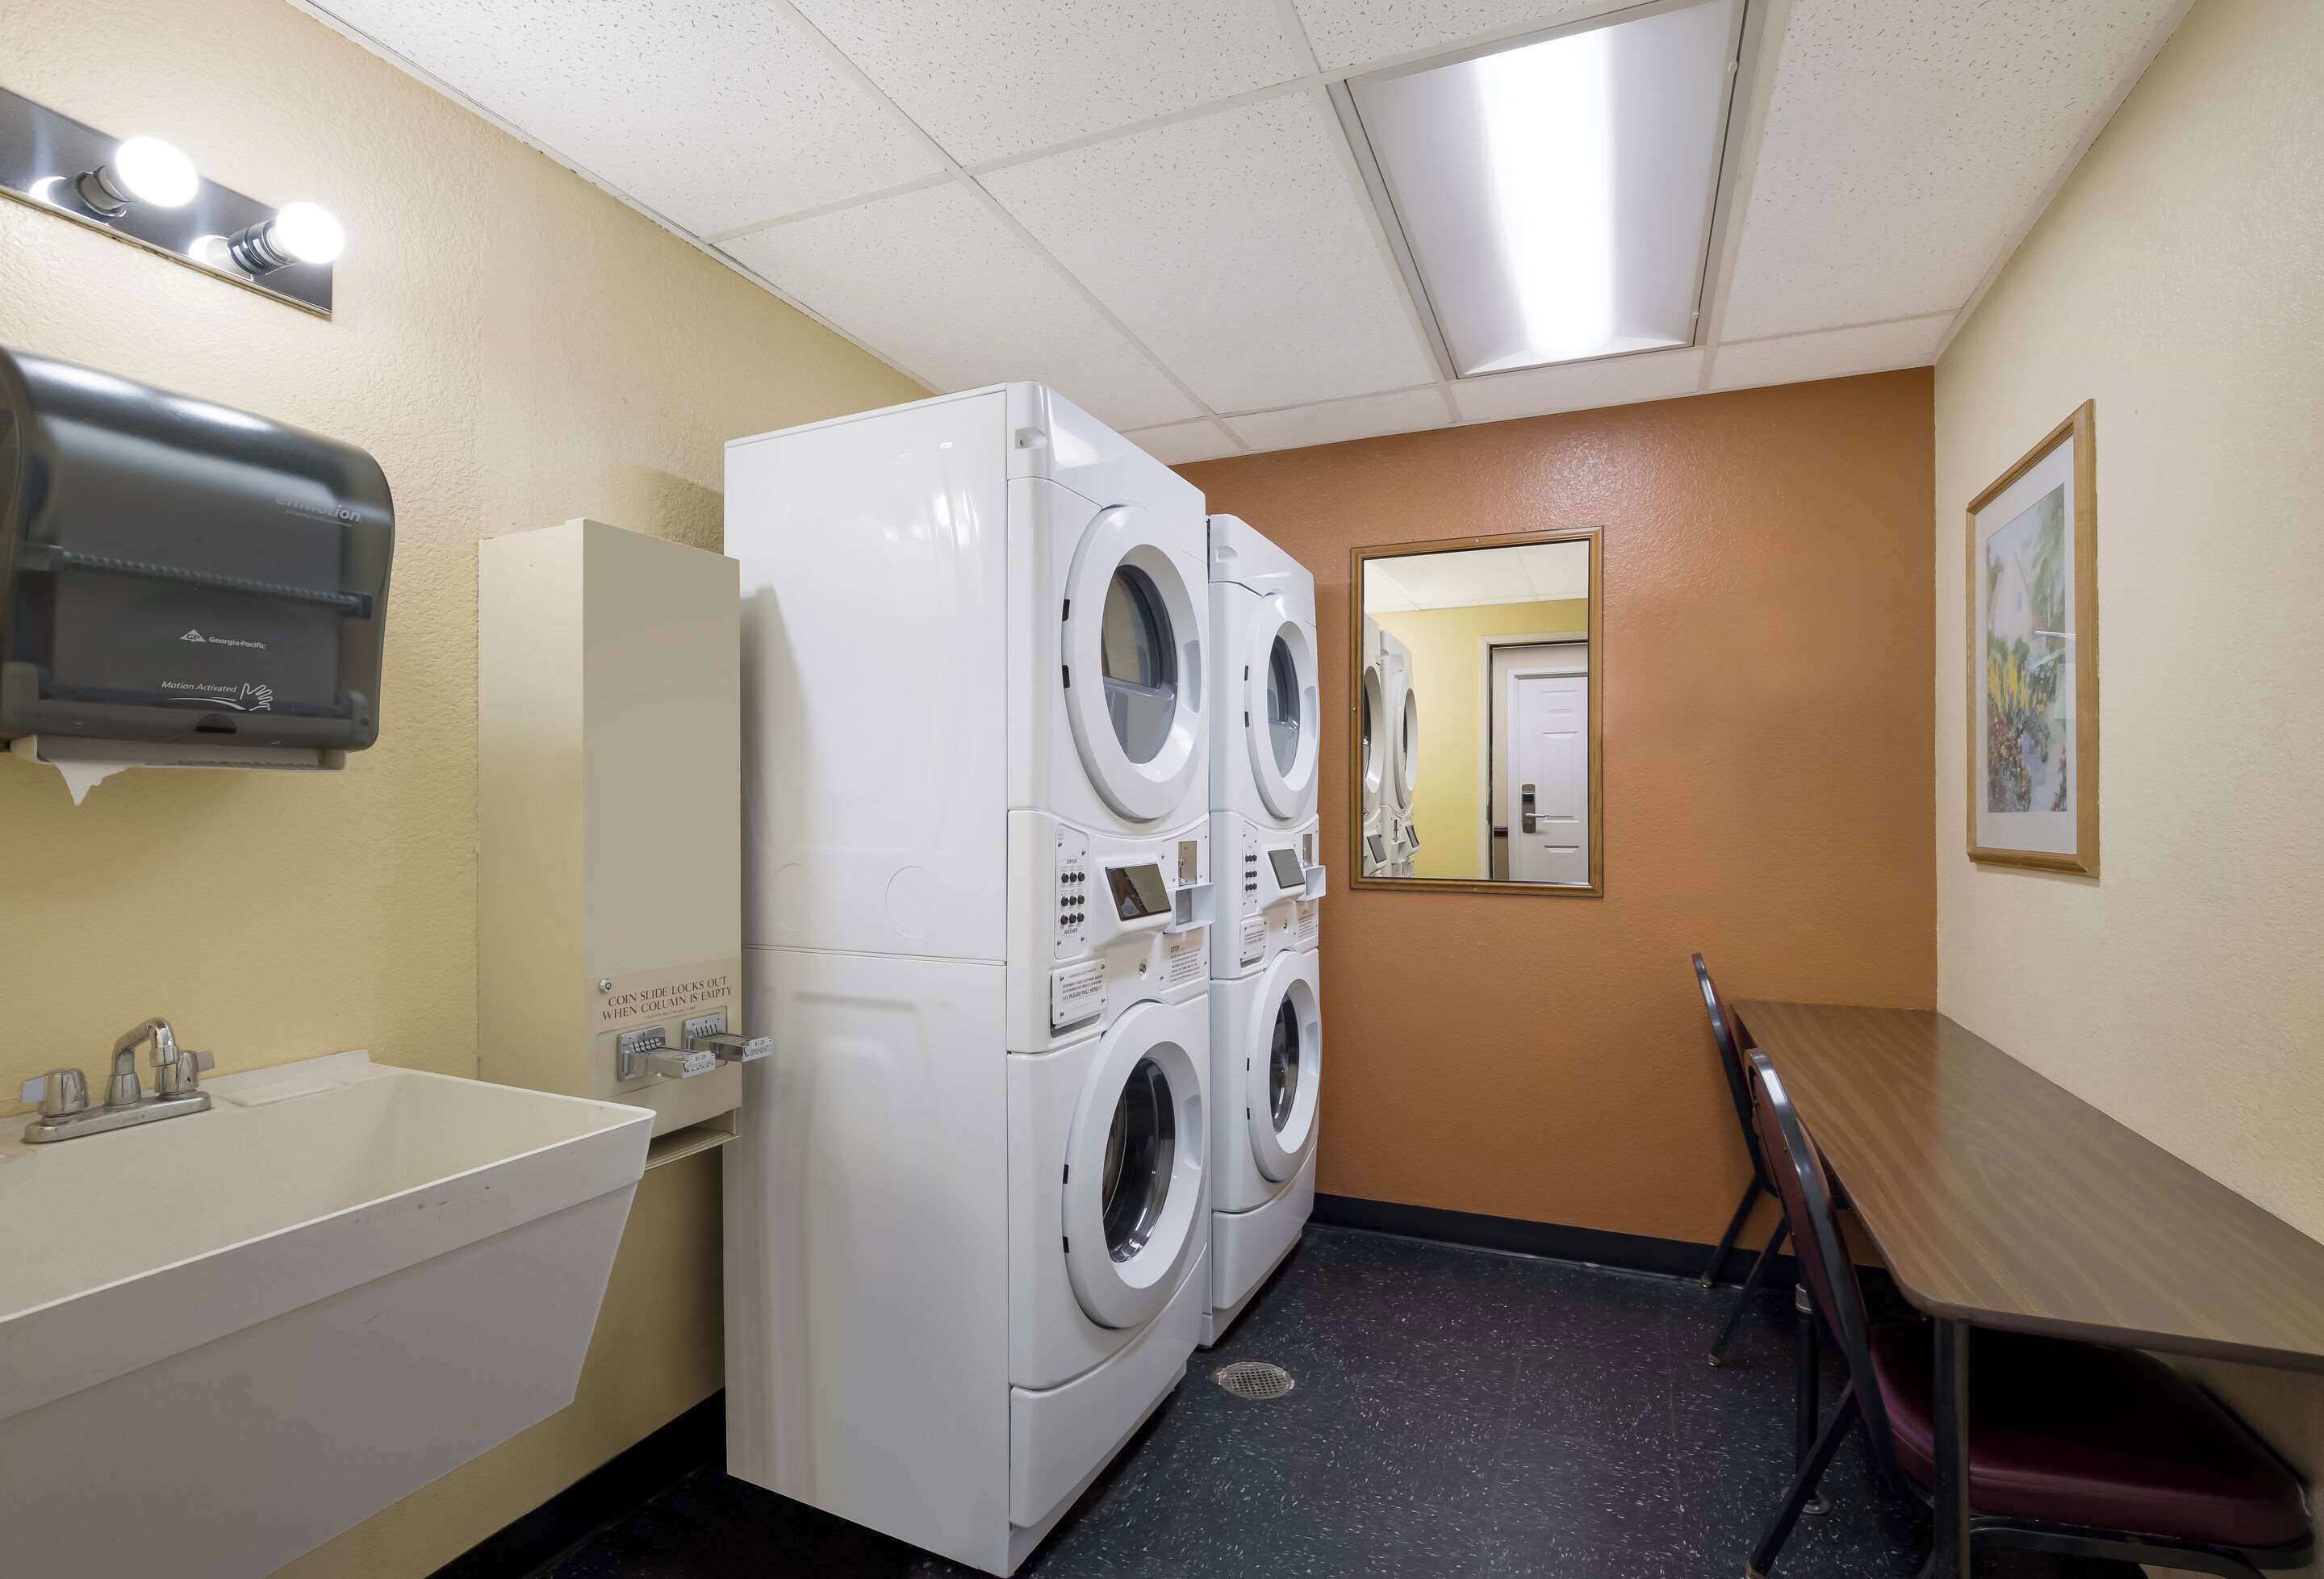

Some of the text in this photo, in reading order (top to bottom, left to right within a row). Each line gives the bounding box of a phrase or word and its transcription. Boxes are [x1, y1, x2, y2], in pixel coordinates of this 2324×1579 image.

[208, 636, 265, 650] Georgia-Pacific
[161, 681, 237, 693] Motion Activated
[608, 976, 728, 1007] COIN SLIDE LOCKS OUT
[602, 1006, 637, 1021] WHEN
[641, 996, 686, 1013] COLUMN
[690, 992, 698, 1003] IS
[701, 987, 733, 1001] EMPTY
